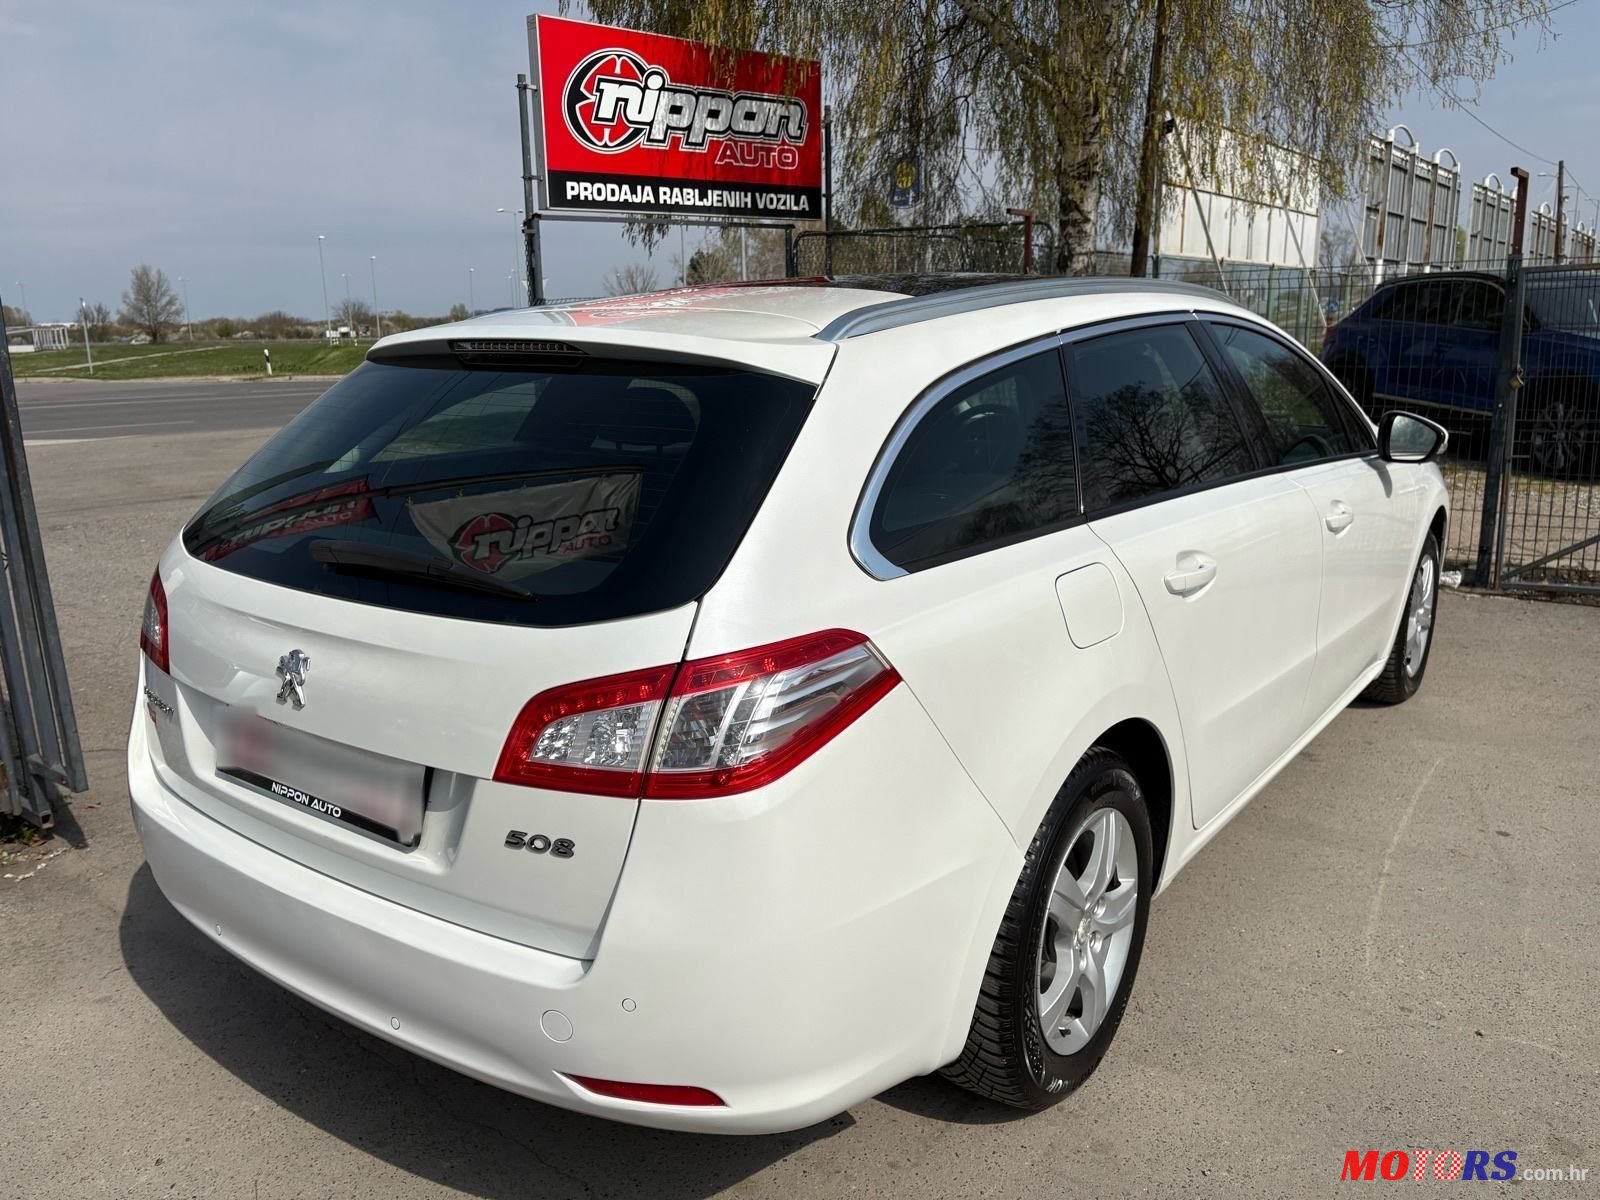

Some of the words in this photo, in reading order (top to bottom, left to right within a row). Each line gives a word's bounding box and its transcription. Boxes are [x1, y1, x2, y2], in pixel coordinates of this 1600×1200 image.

[594, 68, 807, 150] nippon
[715, 141, 798, 169] AUTO
[566, 181, 655, 204] PRODAJA
[659, 186, 751, 208] RABLJENIH
[757, 193, 809, 211] VOZILA
[271, 782, 309, 805] NIPPON
[311, 799, 342, 817] AUTO
[504, 829, 575, 859] 508
